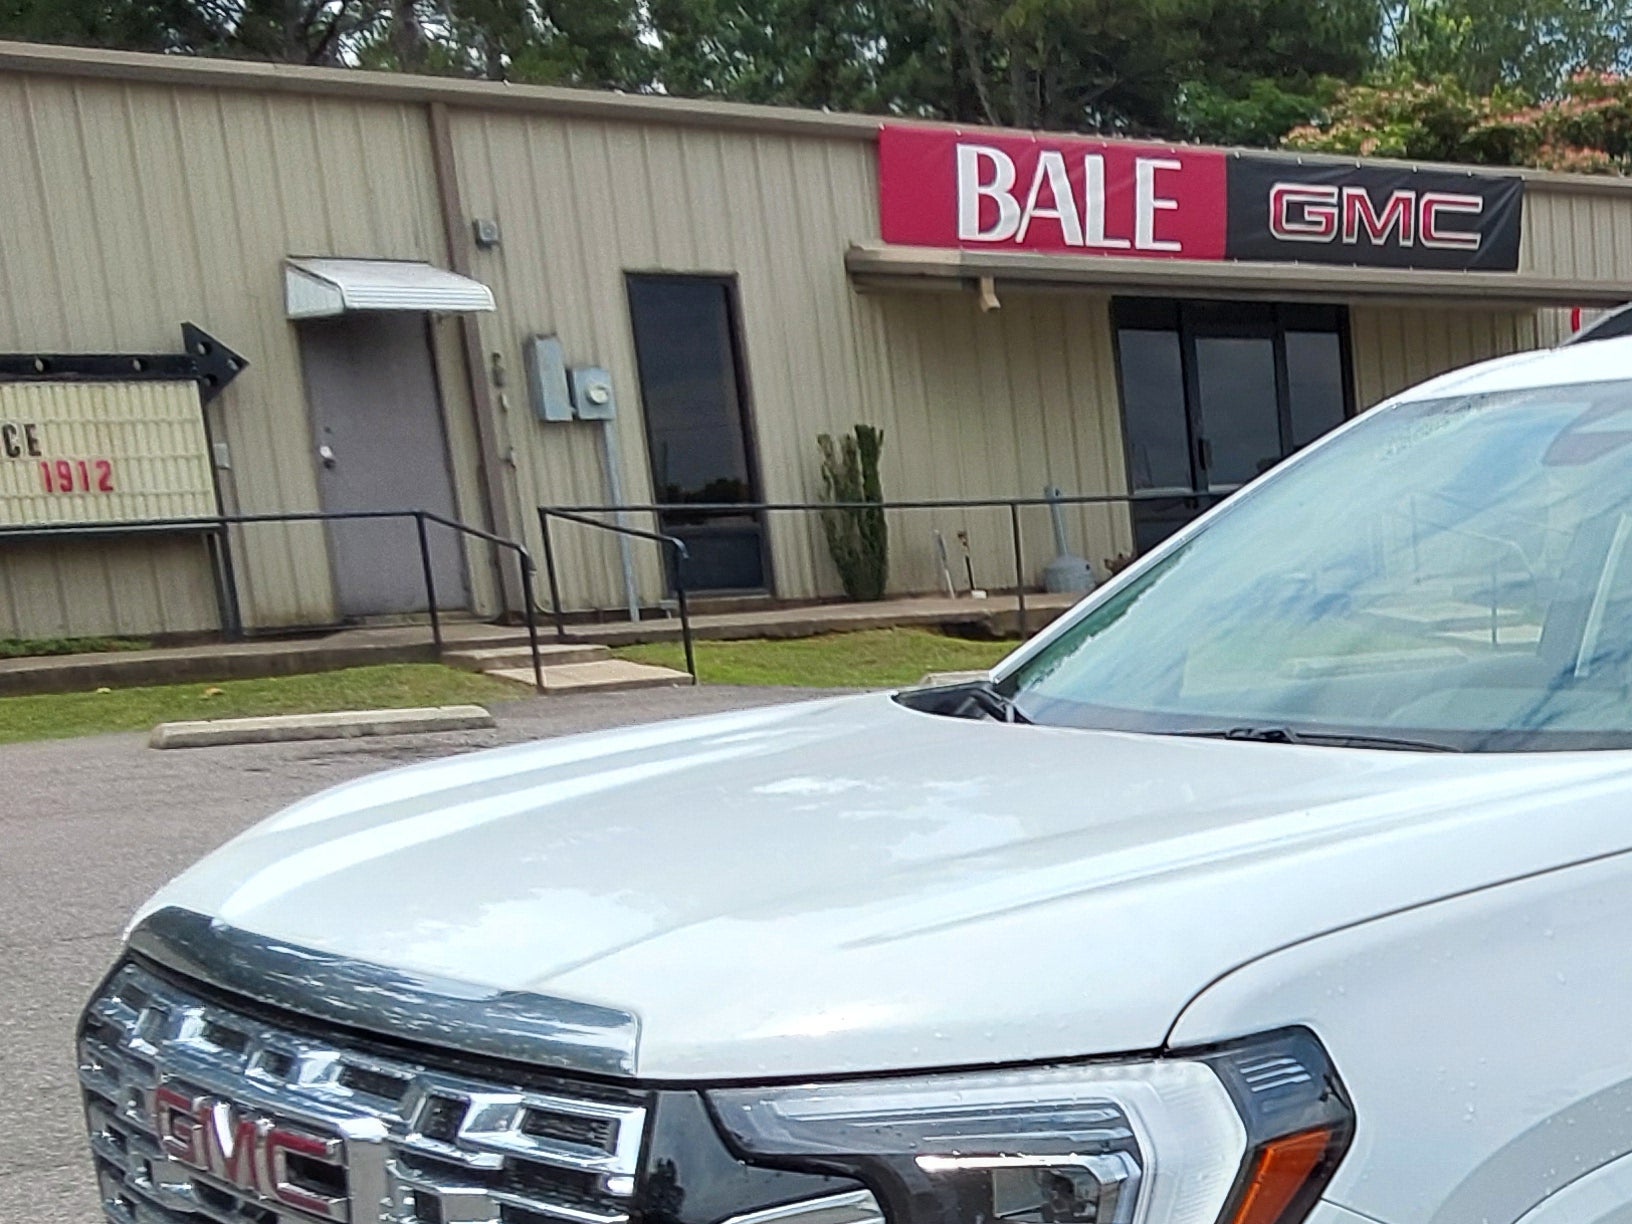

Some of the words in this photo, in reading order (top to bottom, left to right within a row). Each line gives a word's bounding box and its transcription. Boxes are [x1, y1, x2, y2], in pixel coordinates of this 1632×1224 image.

[955, 144, 1182, 252] BALE
[1269, 182, 1483, 250] GMC
[41, 460, 114, 492] 1912
[154, 1086, 349, 1224] GMC
